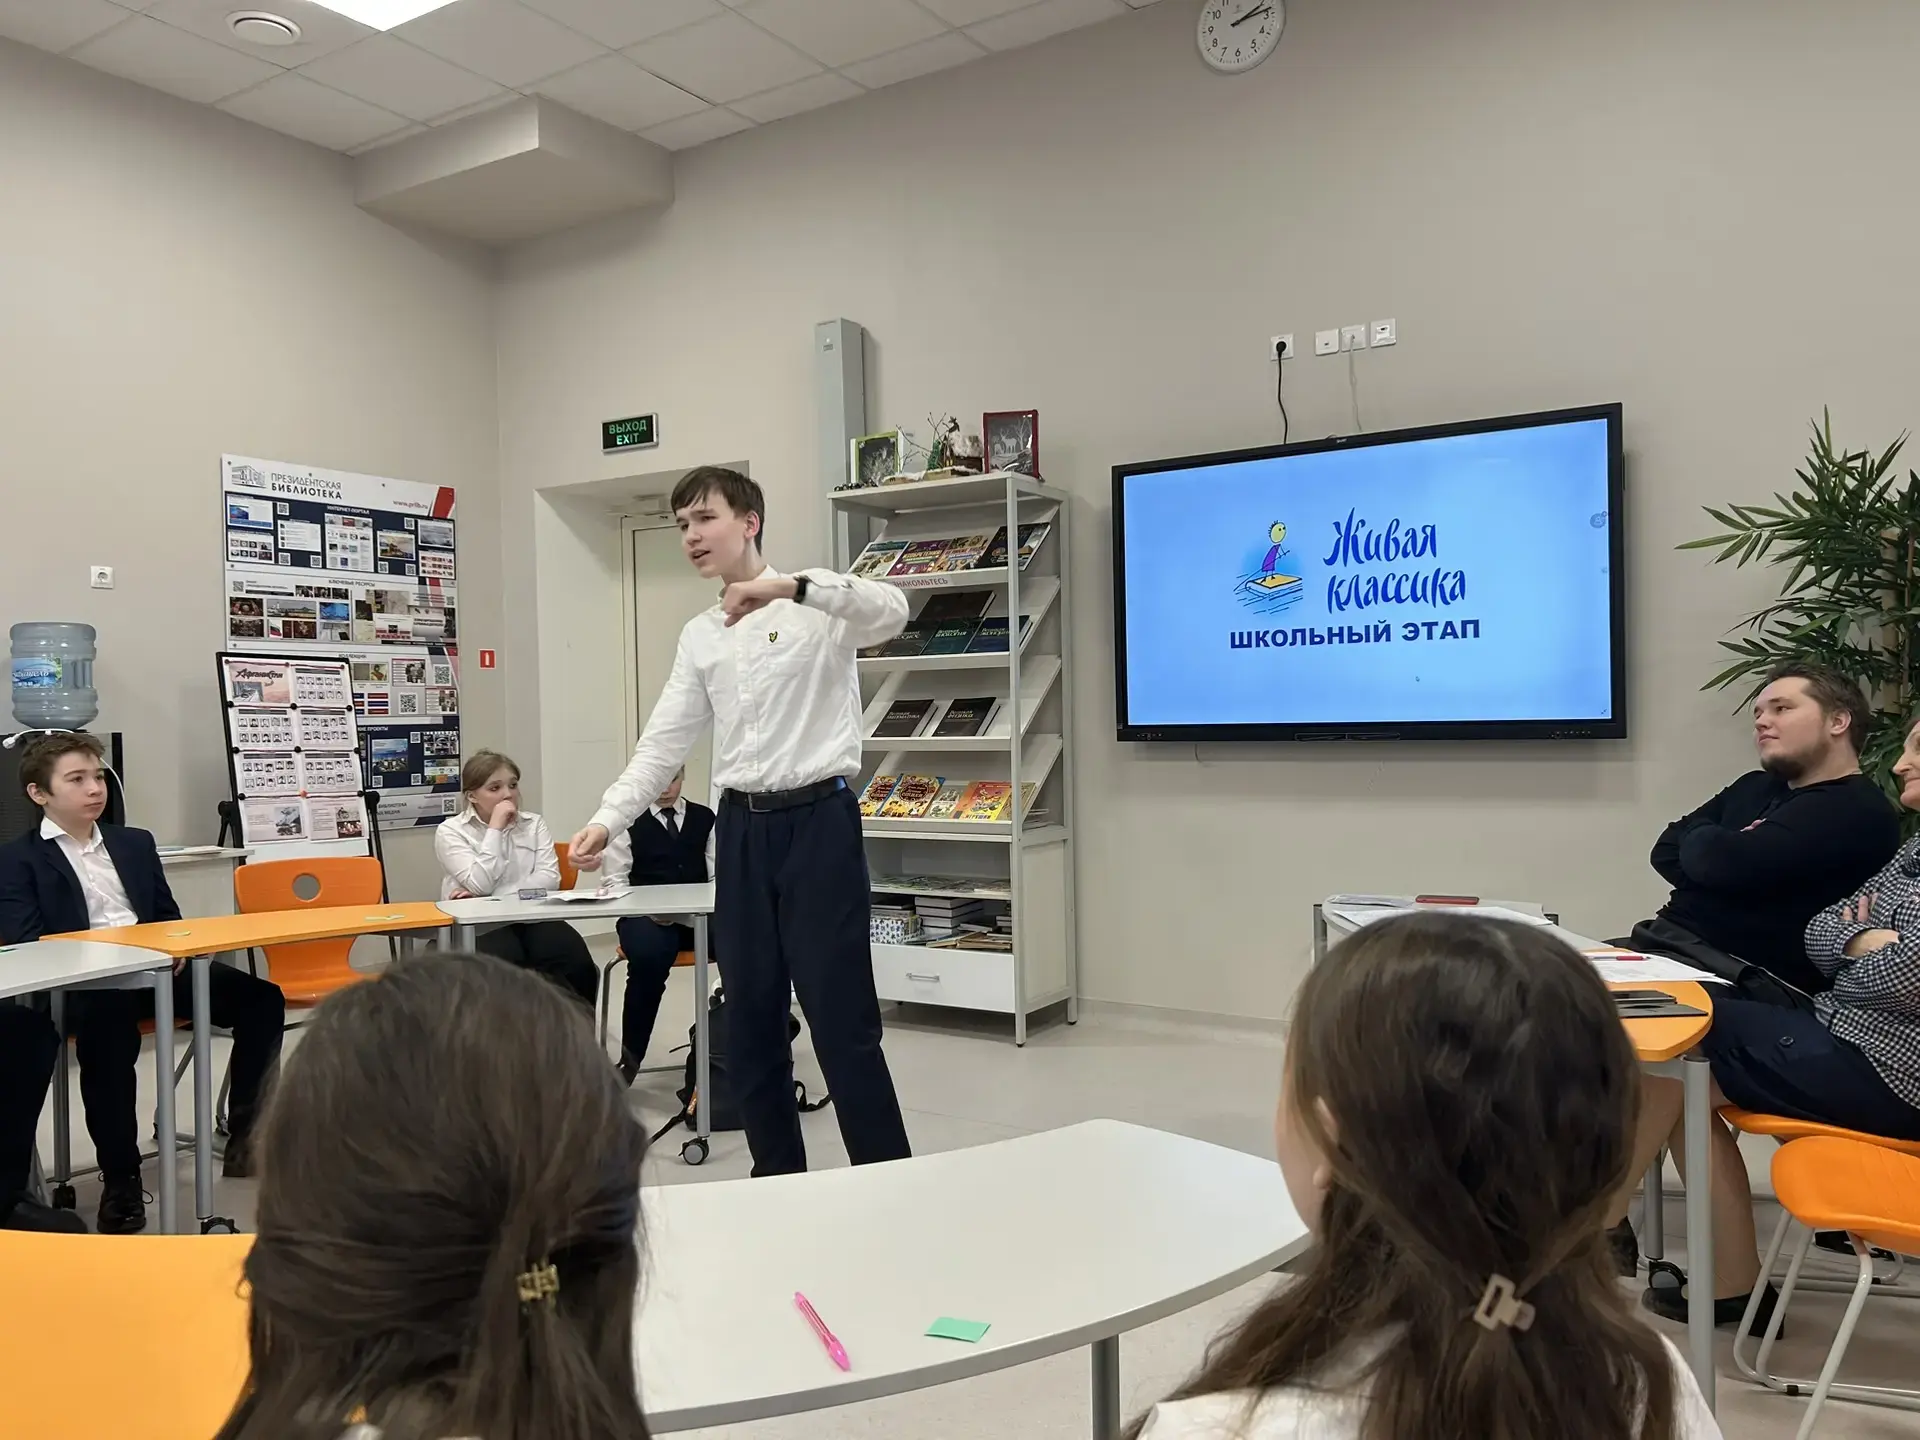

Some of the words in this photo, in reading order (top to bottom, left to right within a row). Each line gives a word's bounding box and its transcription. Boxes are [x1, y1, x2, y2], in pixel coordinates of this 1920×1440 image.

[1212, 9, 1221, 20] 10
[1263, 9, 1269, 20] 3
[1207, 25, 1214, 35] 9
[1259, 25, 1265, 34] 4
[1212, 38, 1218, 48] 8
[1250, 38, 1257, 49] 5
[1221, 46, 1227, 57] 7
[1235, 48, 1241, 57] 6
[608, 419, 647, 434] ВЫХОД
[616, 432, 639, 445] EXIT
[270, 472, 342, 491] ПРЕЗИДЕНТСКАЯ
[271, 483, 343, 500] БИБЛИОТЕКА
[1323, 507, 1437, 567] Живая
[1328, 567, 1466, 614] классика
[1230, 619, 1391, 649] ШКОЛЬНЫЙ
[1401, 619, 1480, 642] ЭТАП
